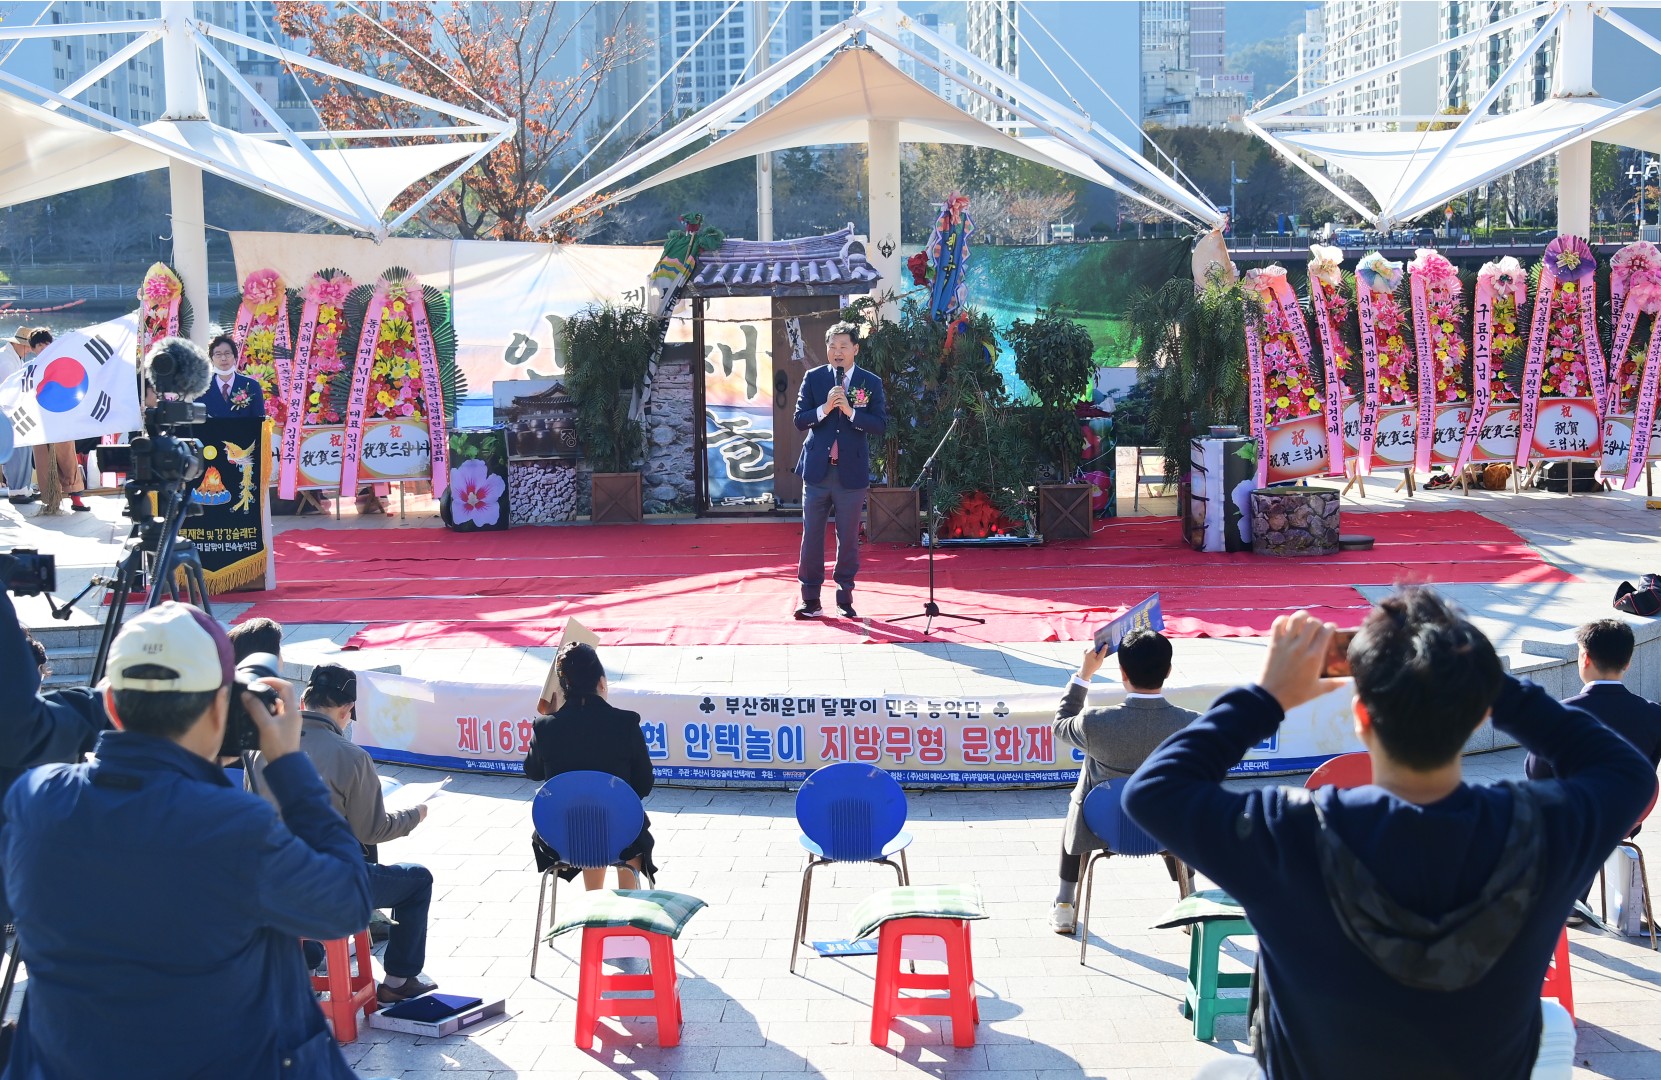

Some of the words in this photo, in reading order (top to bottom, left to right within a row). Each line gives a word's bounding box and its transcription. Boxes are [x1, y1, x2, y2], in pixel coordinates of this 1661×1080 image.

[1314, 292, 1331, 351] 가야밀면
[1476, 304, 1489, 381] 구룡스님
[1325, 356, 1338, 384] 대표
[1365, 369, 1377, 394] 대표
[350, 410, 361, 428] 대표
[1328, 391, 1340, 437] 김경애
[330, 433, 342, 447] 祝
[390, 424, 402, 438] 祝
[1292, 429, 1309, 448] 祝
[282, 428, 297, 464] 김성수
[178, 528, 205, 540] 택재현
[206, 530, 214, 540] 및
[214, 527, 257, 540] 강강술래단
[204, 542, 224, 552] 달맞이
[726, 698, 816, 716] 부산해운대
[821, 697, 877, 717] 달맞이
[885, 699, 918, 719] 민속
[927, 700, 984, 720] 농악단
[684, 722, 805, 761] 안택놀이
[819, 725, 944, 763] 지방무형
[962, 726, 1055, 763] 문화재
